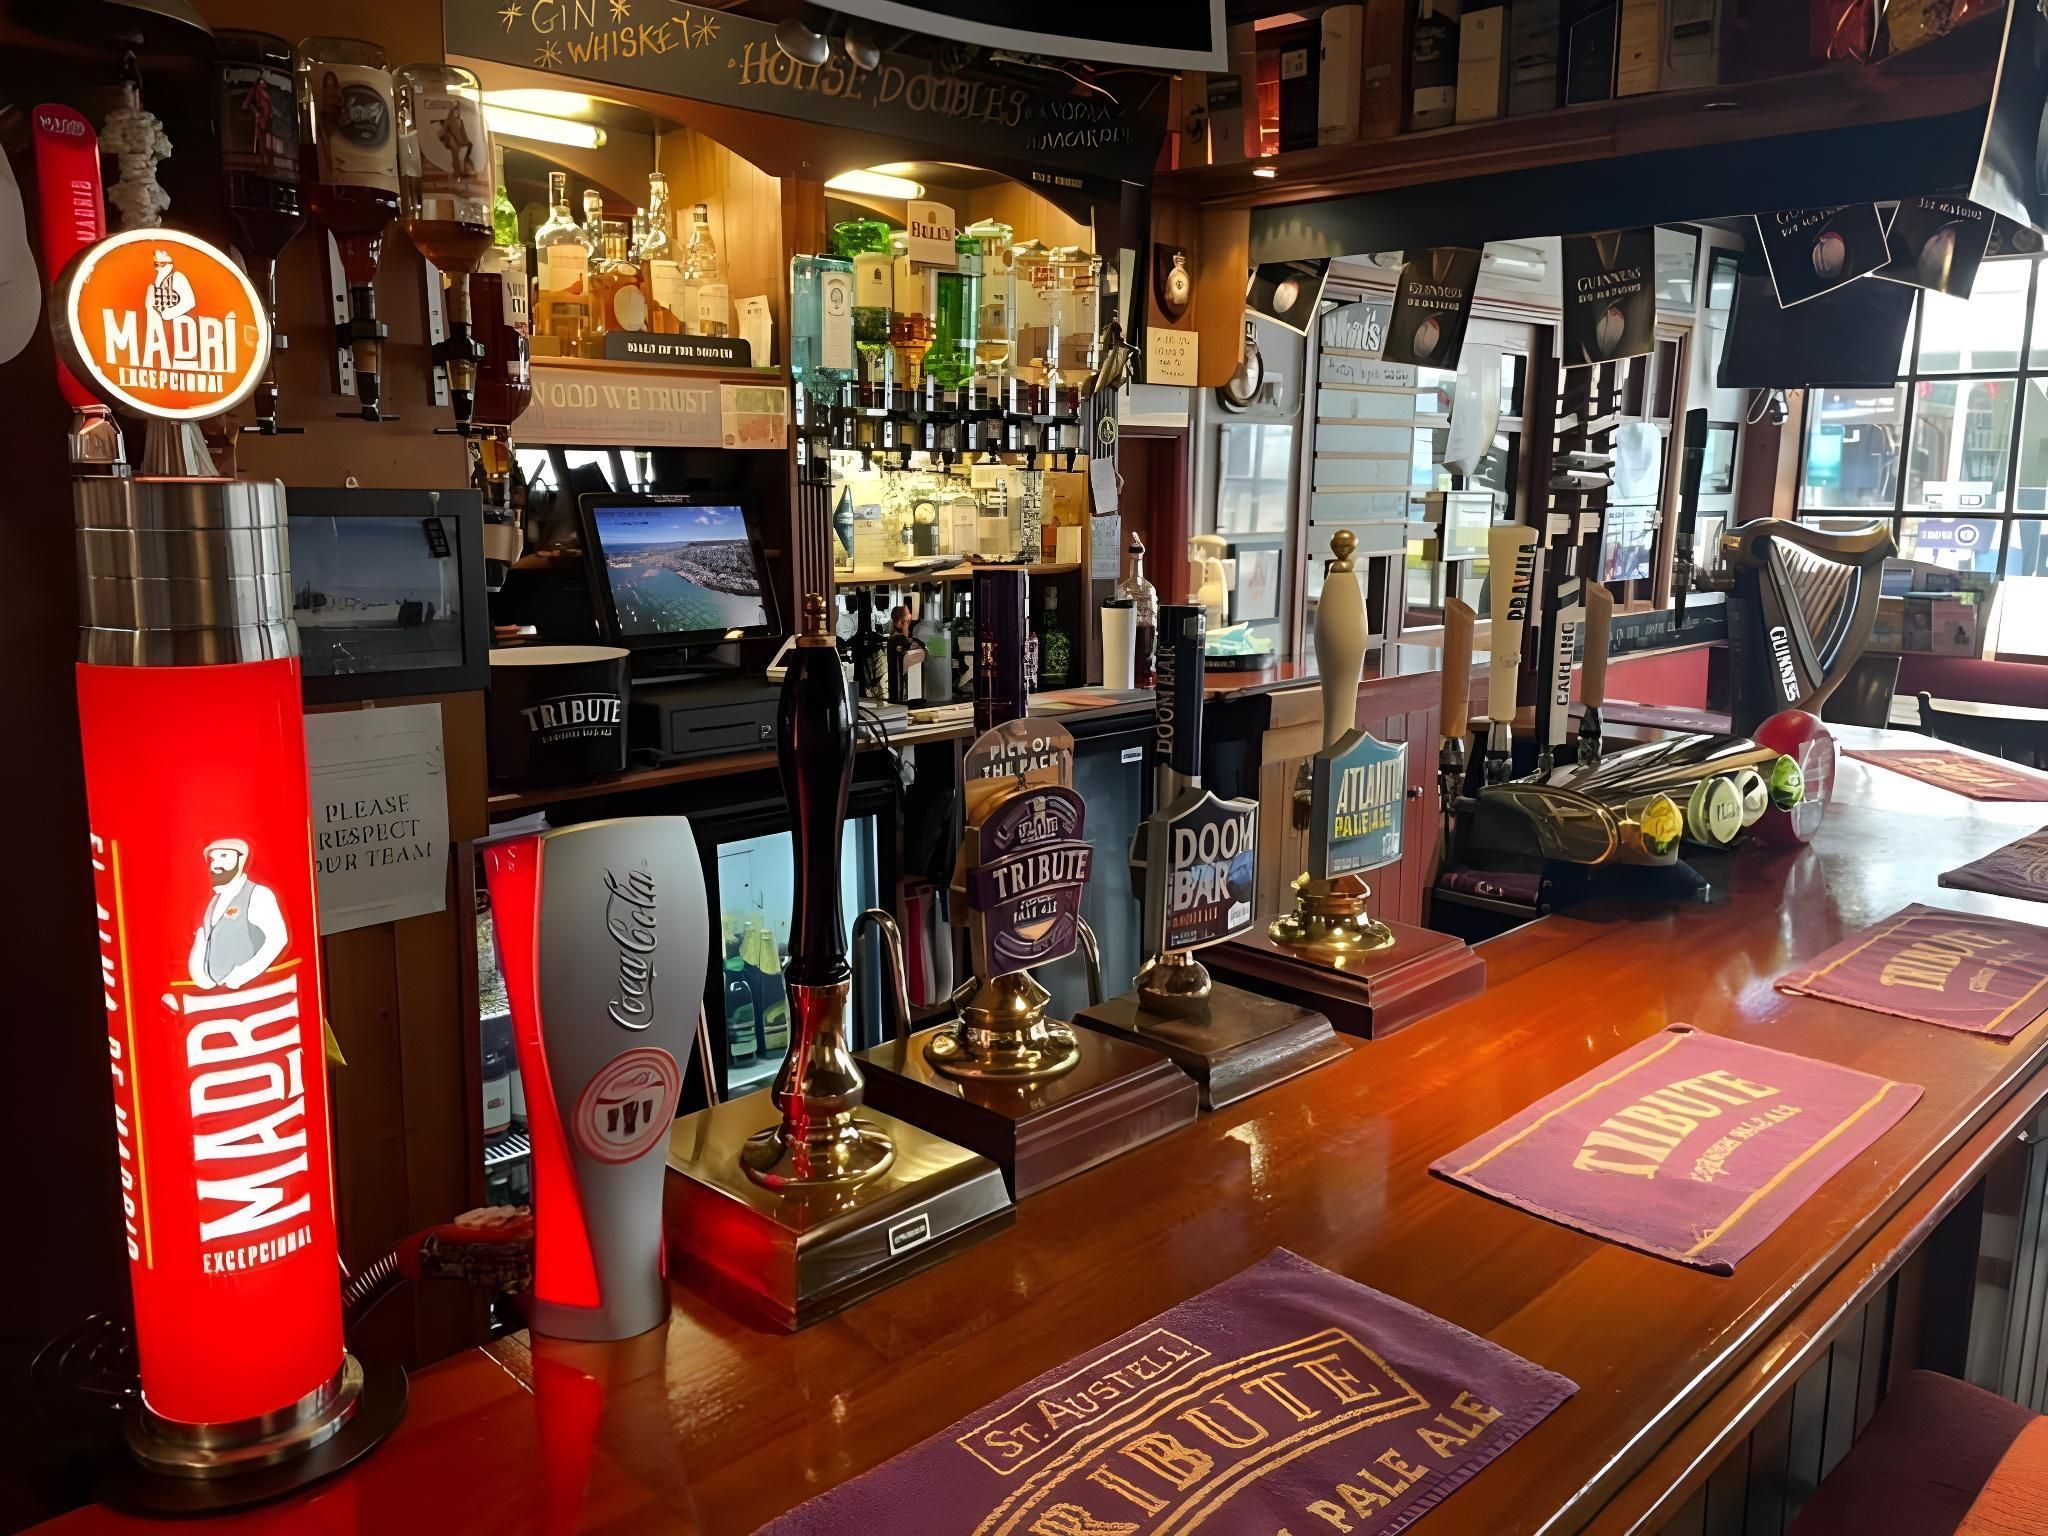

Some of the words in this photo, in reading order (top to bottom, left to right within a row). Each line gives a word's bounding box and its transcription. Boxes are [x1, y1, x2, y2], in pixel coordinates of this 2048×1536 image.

[531, 0, 596, 33] GIN
[568, 11, 690, 64] WHISKEY
[874, 64, 1027, 127] DOUBLES
[641, 387, 715, 414] TRUST
[519, 698, 621, 733] TRIBUTE
[991, 741, 1028, 761] PICK
[1020, 752, 1059, 774] PACK
[326, 794, 410, 823] PLEASE
[319, 820, 421, 851] RESPECT
[365, 842, 432, 867] TEAM
[1174, 811, 1255, 870] DOOM
[992, 849, 1090, 898] TRIBUTE
[1173, 861, 1231, 912] BAR
[1572, 1069, 1782, 1180] TRIBUTE
[1037, 1346, 1191, 1431] AUSTELL
[1027, 1353, 1382, 1536] RIBUTE
[1306, 1448, 1431, 1534] PALE
[1416, 1390, 1505, 1460] ALE
